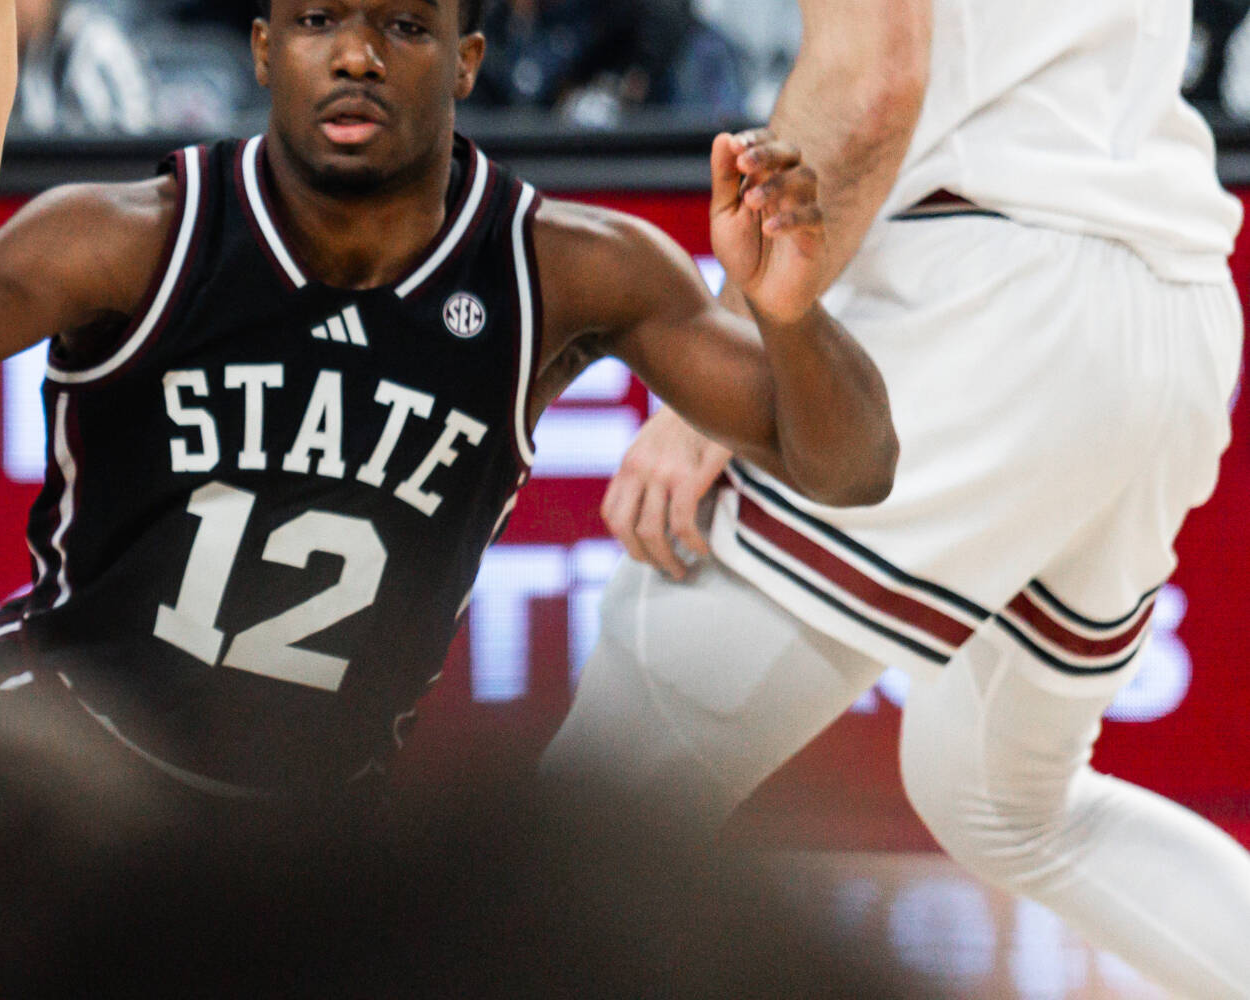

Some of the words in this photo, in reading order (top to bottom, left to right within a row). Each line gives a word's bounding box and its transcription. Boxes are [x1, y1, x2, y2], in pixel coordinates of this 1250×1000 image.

[447, 297, 482, 334] SEC
[162, 363, 489, 517] STATE
[153, 480, 388, 691] 12
